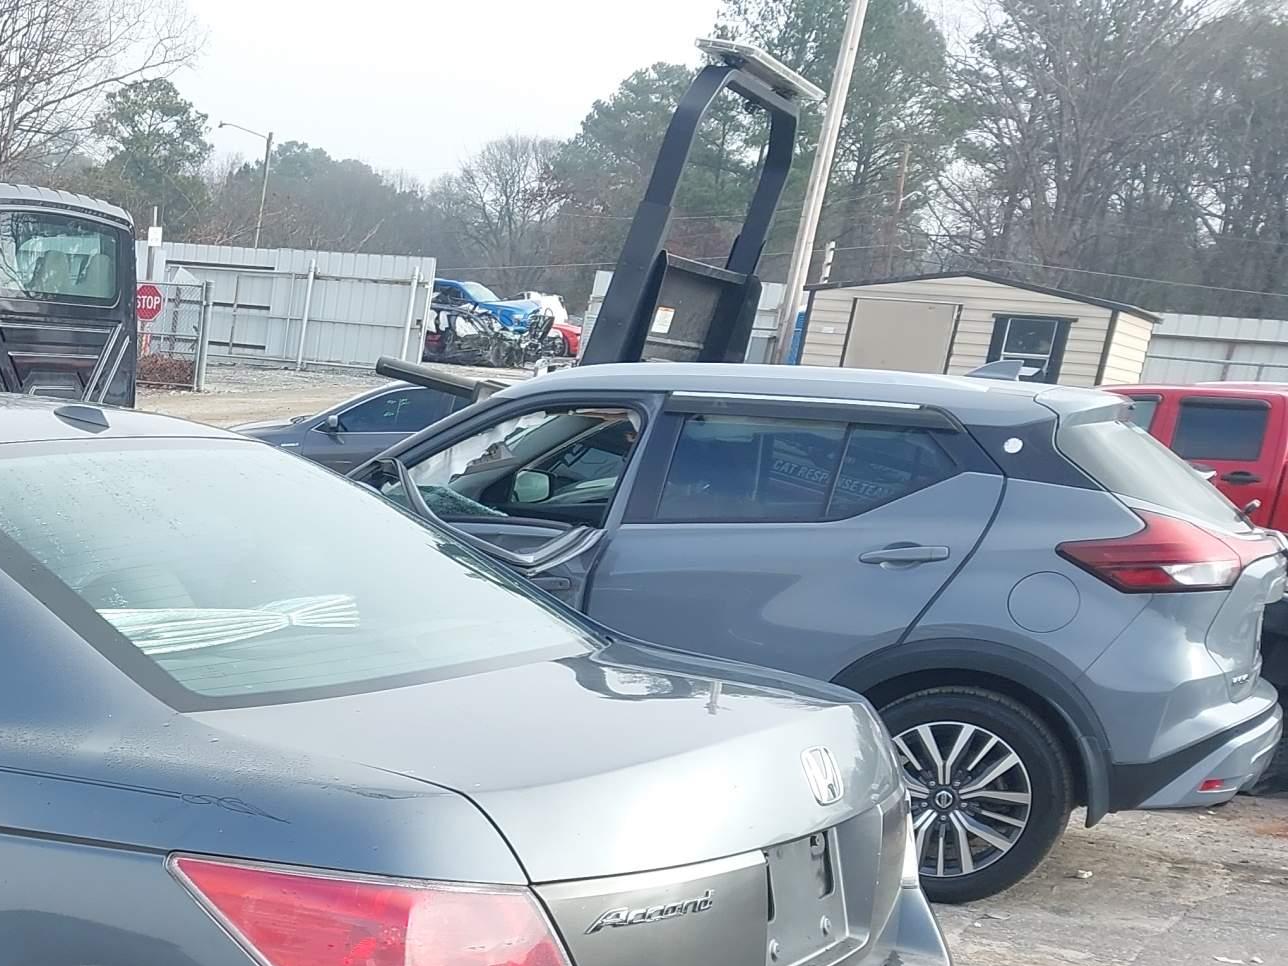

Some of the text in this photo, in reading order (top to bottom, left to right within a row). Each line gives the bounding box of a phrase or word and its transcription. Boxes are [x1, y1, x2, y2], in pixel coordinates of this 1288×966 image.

[137, 295, 161, 309] STOP
[774, 459, 798, 474] CAT
[797, 465, 860, 491] RESPNSE
[584, 889, 715, 935] Accord
